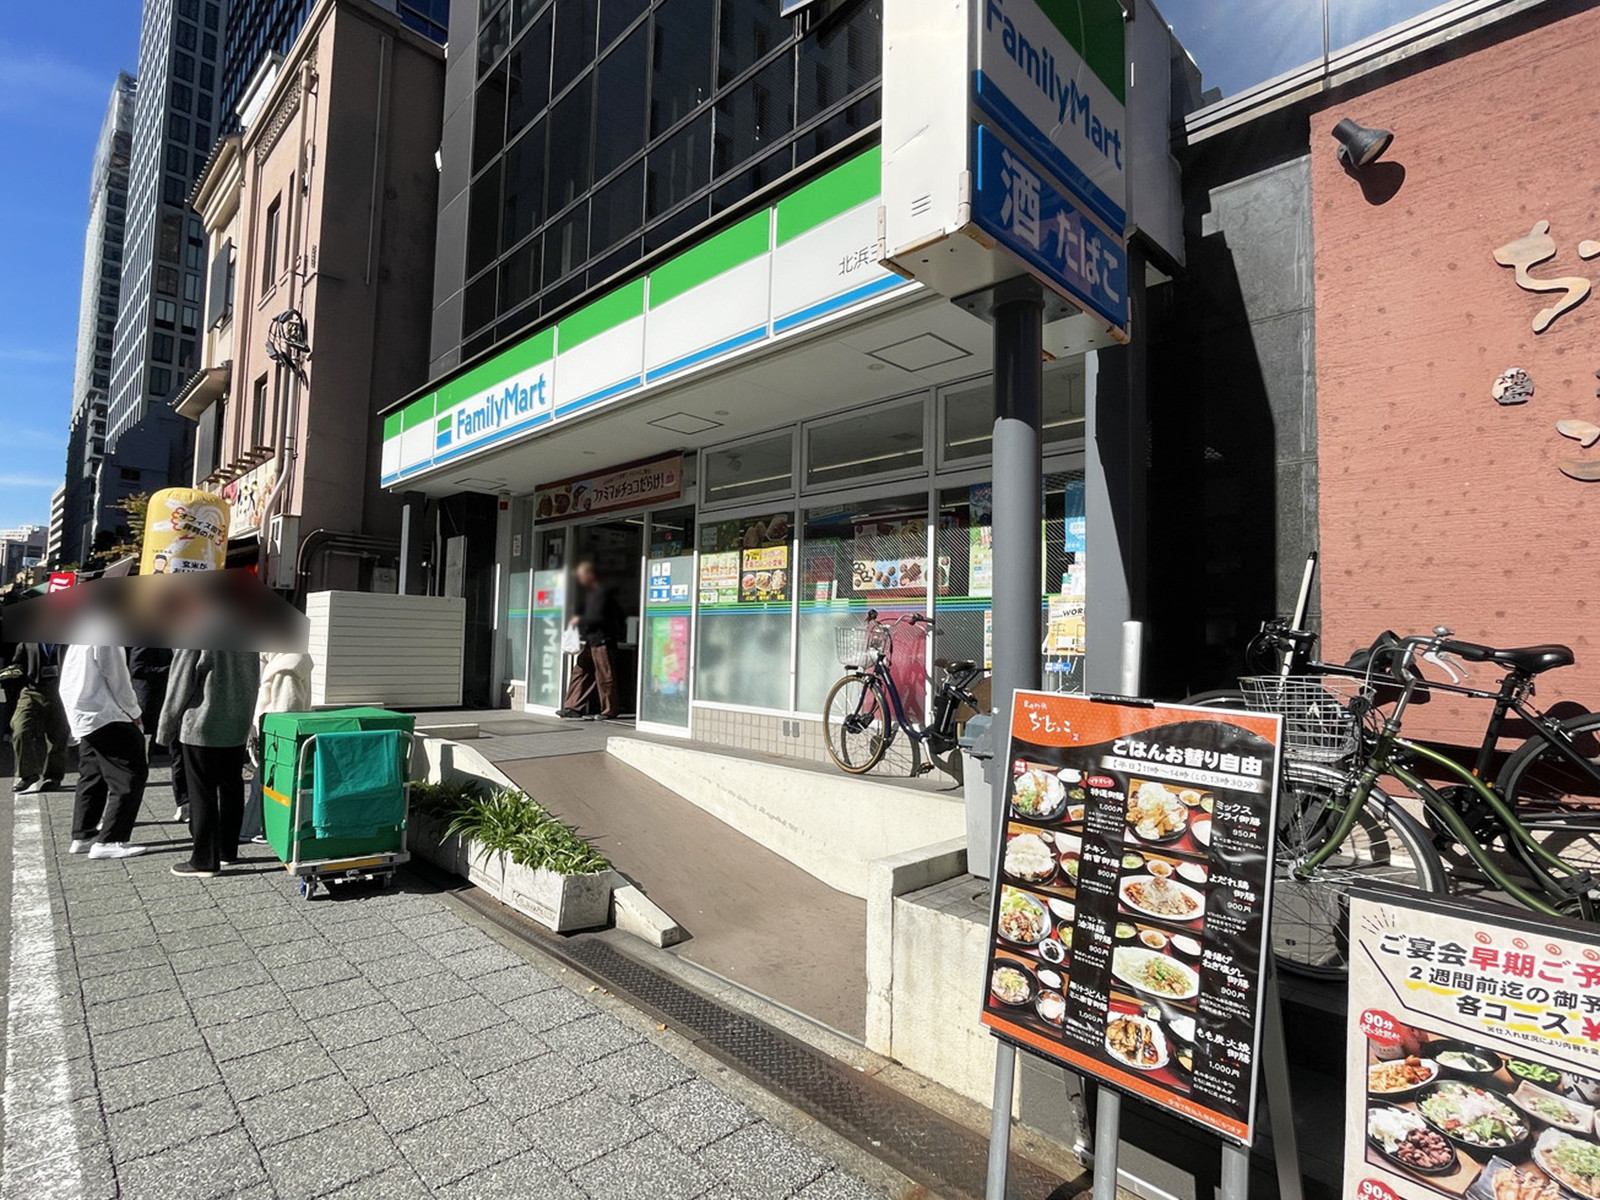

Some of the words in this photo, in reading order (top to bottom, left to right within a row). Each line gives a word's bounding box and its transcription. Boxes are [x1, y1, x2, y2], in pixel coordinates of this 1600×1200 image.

[1001, 148, 1041, 251] 酒
[1056, 208, 1120, 304] たばこ
[457, 373, 546, 439] FamilyMart
[1112, 739, 1263, 777] ごはんお替り自由
[1090, 787, 1126, 801] 特選御膳
[1099, 803, 1123, 814] 1,000円
[1216, 800, 1252, 816] ミックス
[1216, 811, 1261, 827] フライ御膳
[1232, 828, 1257, 840] 950円
[1084, 843, 1108, 855] チキン
[1209, 873, 1250, 891] よだれ鶏
[1233, 889, 1256, 903] 御膳
[1226, 901, 1252, 914] 900円
[1077, 920, 1106, 935] 油淋鶏
[1094, 932, 1113, 945] 御膳
[1203, 949, 1233, 965] 唐揚げ
[1202, 958, 1245, 978] ねぎ塩ダレ
[1226, 975, 1250, 989] 御膳
[1220, 986, 1246, 1000] 900円
[1363, 1011, 1394, 1031] 90分
[1196, 1027, 1251, 1055] もも炭火焼
[1226, 1048, 1251, 1065] 御膳
[1208, 1060, 1240, 1079] 1,000円
